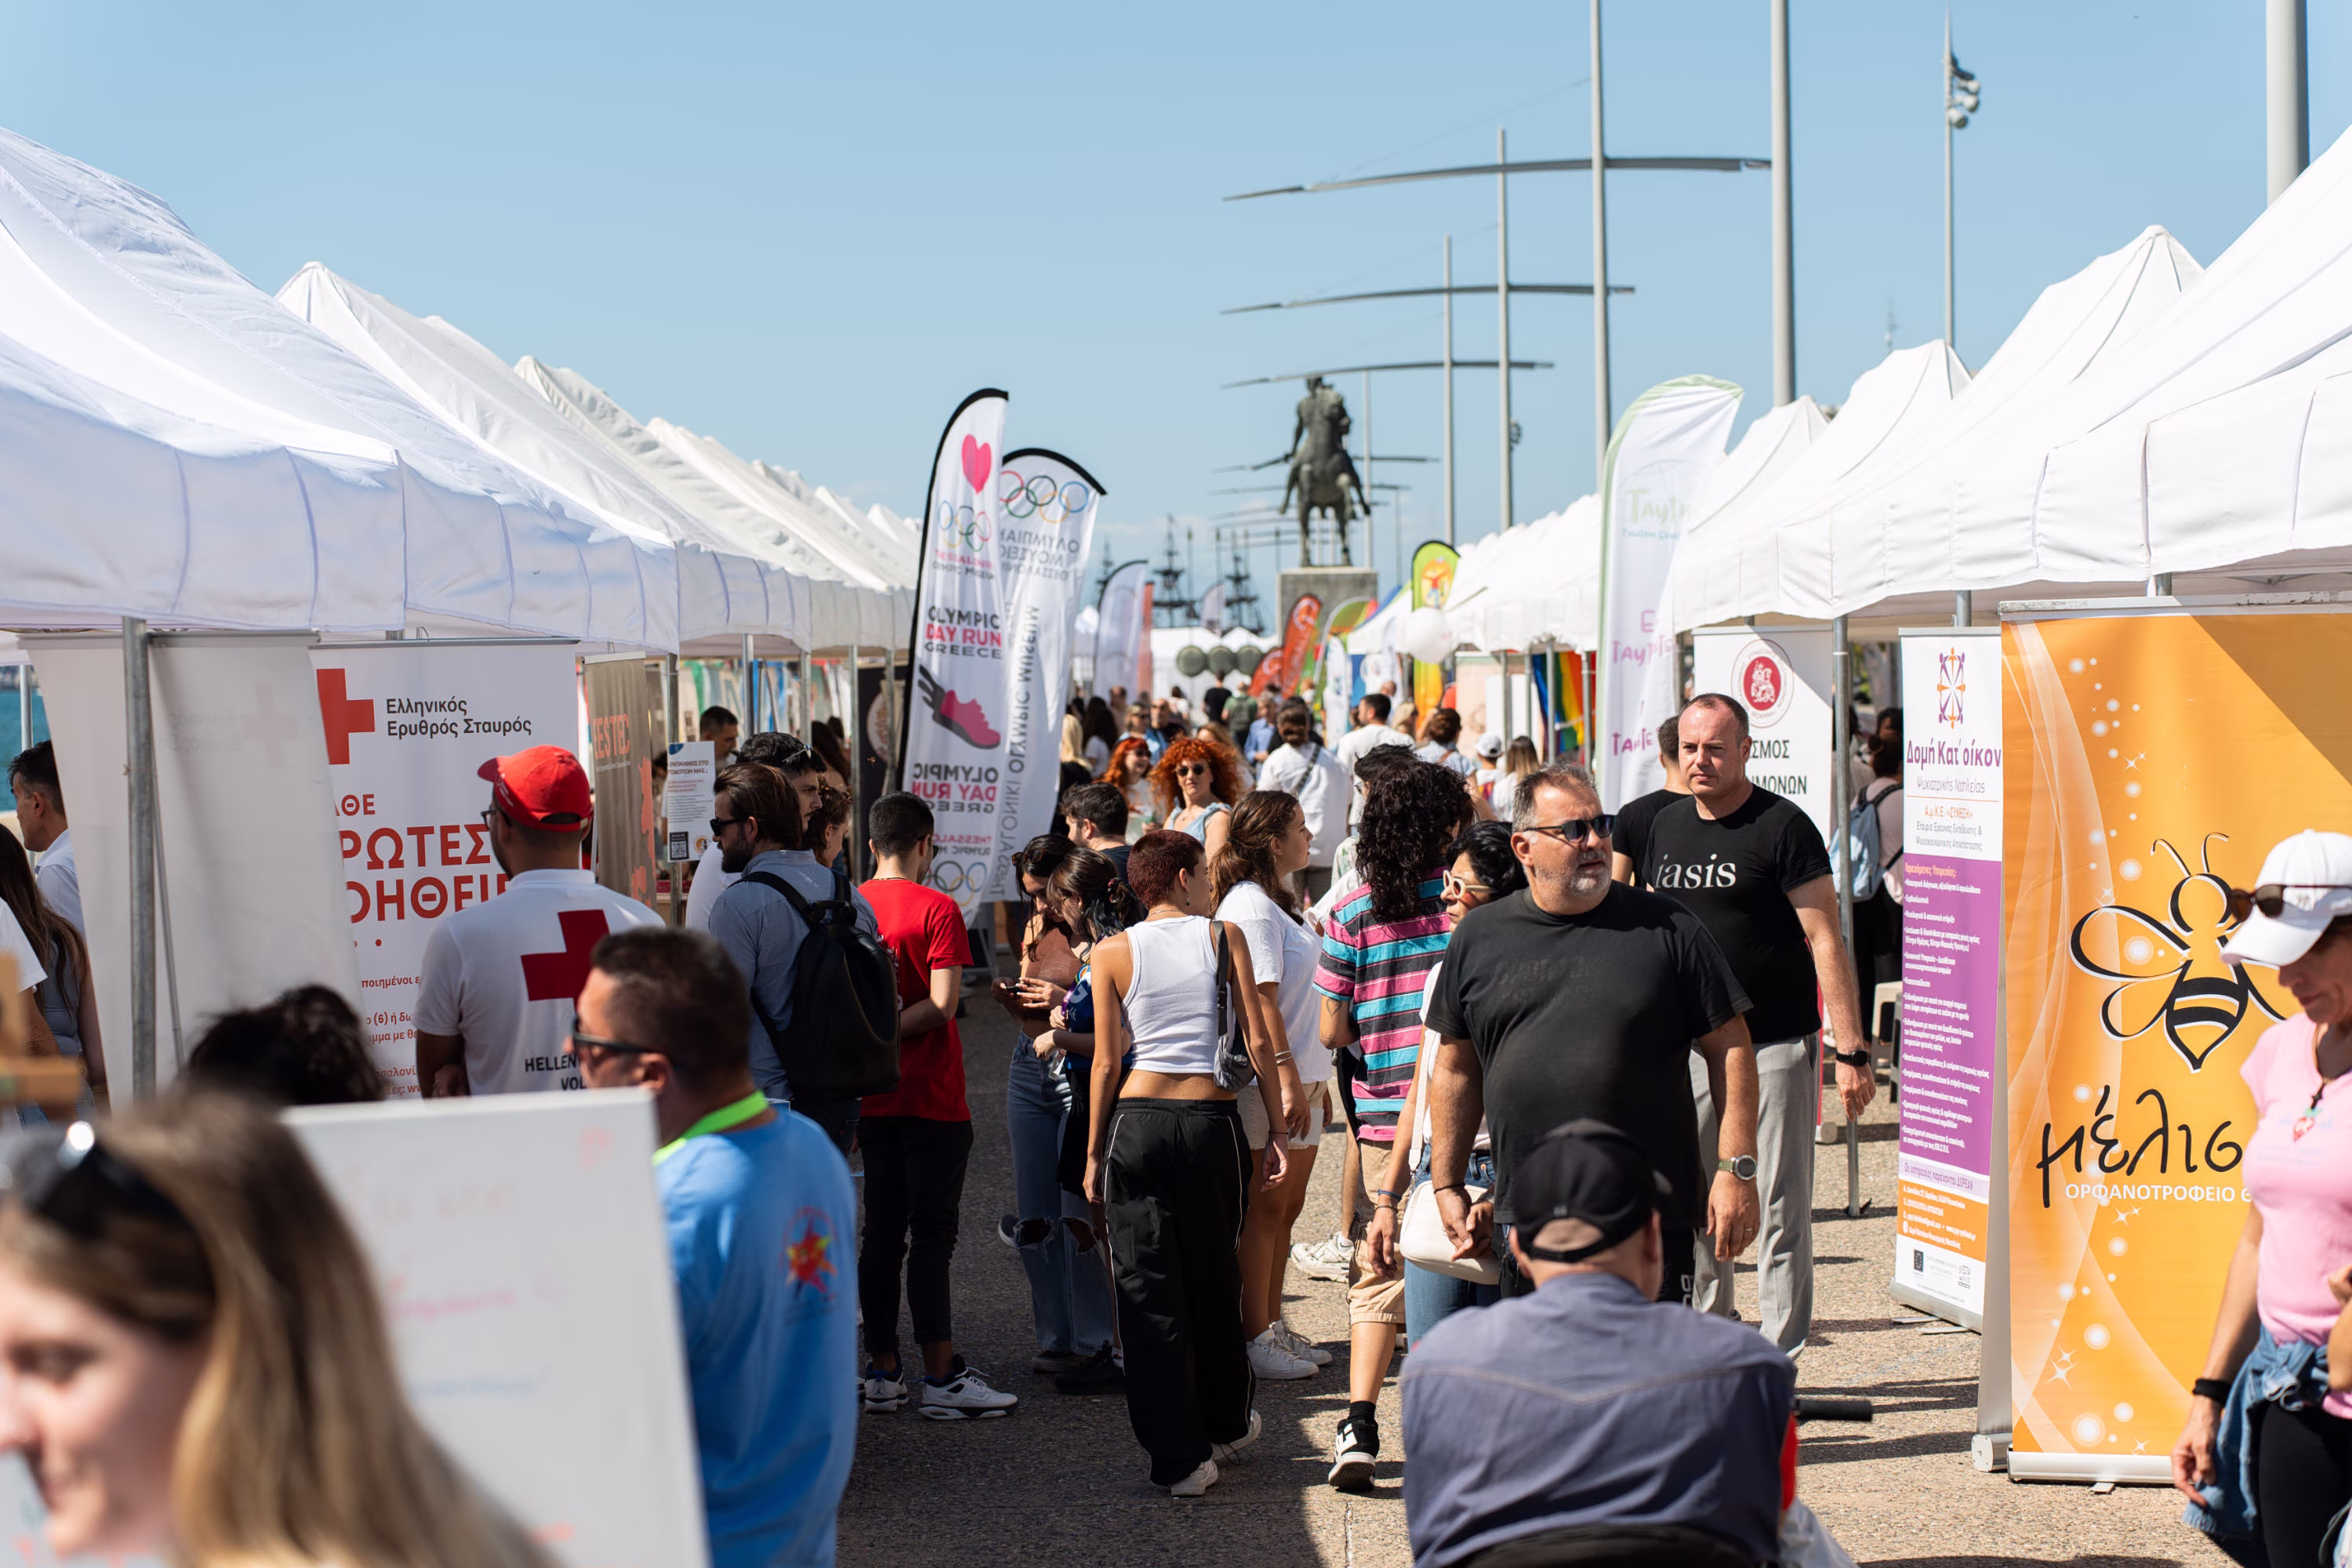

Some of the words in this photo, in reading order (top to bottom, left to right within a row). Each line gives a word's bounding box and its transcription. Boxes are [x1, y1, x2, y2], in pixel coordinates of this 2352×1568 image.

[927, 605, 1000, 630] OLYMPIC
[925, 623, 957, 643] DAY
[962, 628, 1002, 648] RUN
[925, 641, 1003, 660] GREECE
[387, 696, 467, 717] Ελληνικός
[387, 718, 459, 739] Ερυθρός
[463, 716, 532, 736] Σταυρός
[1749, 739, 1790, 759] ΣΜΟΣ
[1907, 737, 1935, 770] Δομή
[1963, 739, 2002, 768] οίκον
[339, 823, 491, 870] ΡΩΤΕΣ
[1655, 854, 1737, 890] iasis
[361, 975, 413, 989] ποιημένοι
[374, 1011, 387, 1025] (6)
[391, 1012, 397, 1025] ή
[393, 1032, 405, 1043] με
[524, 1053, 577, 1073] HELLEN
[561, 1076, 587, 1091] VOL
[2065, 1182, 2236, 1202] ΟΡΦΑΝΟΤΡΟΦΕΙΟ
